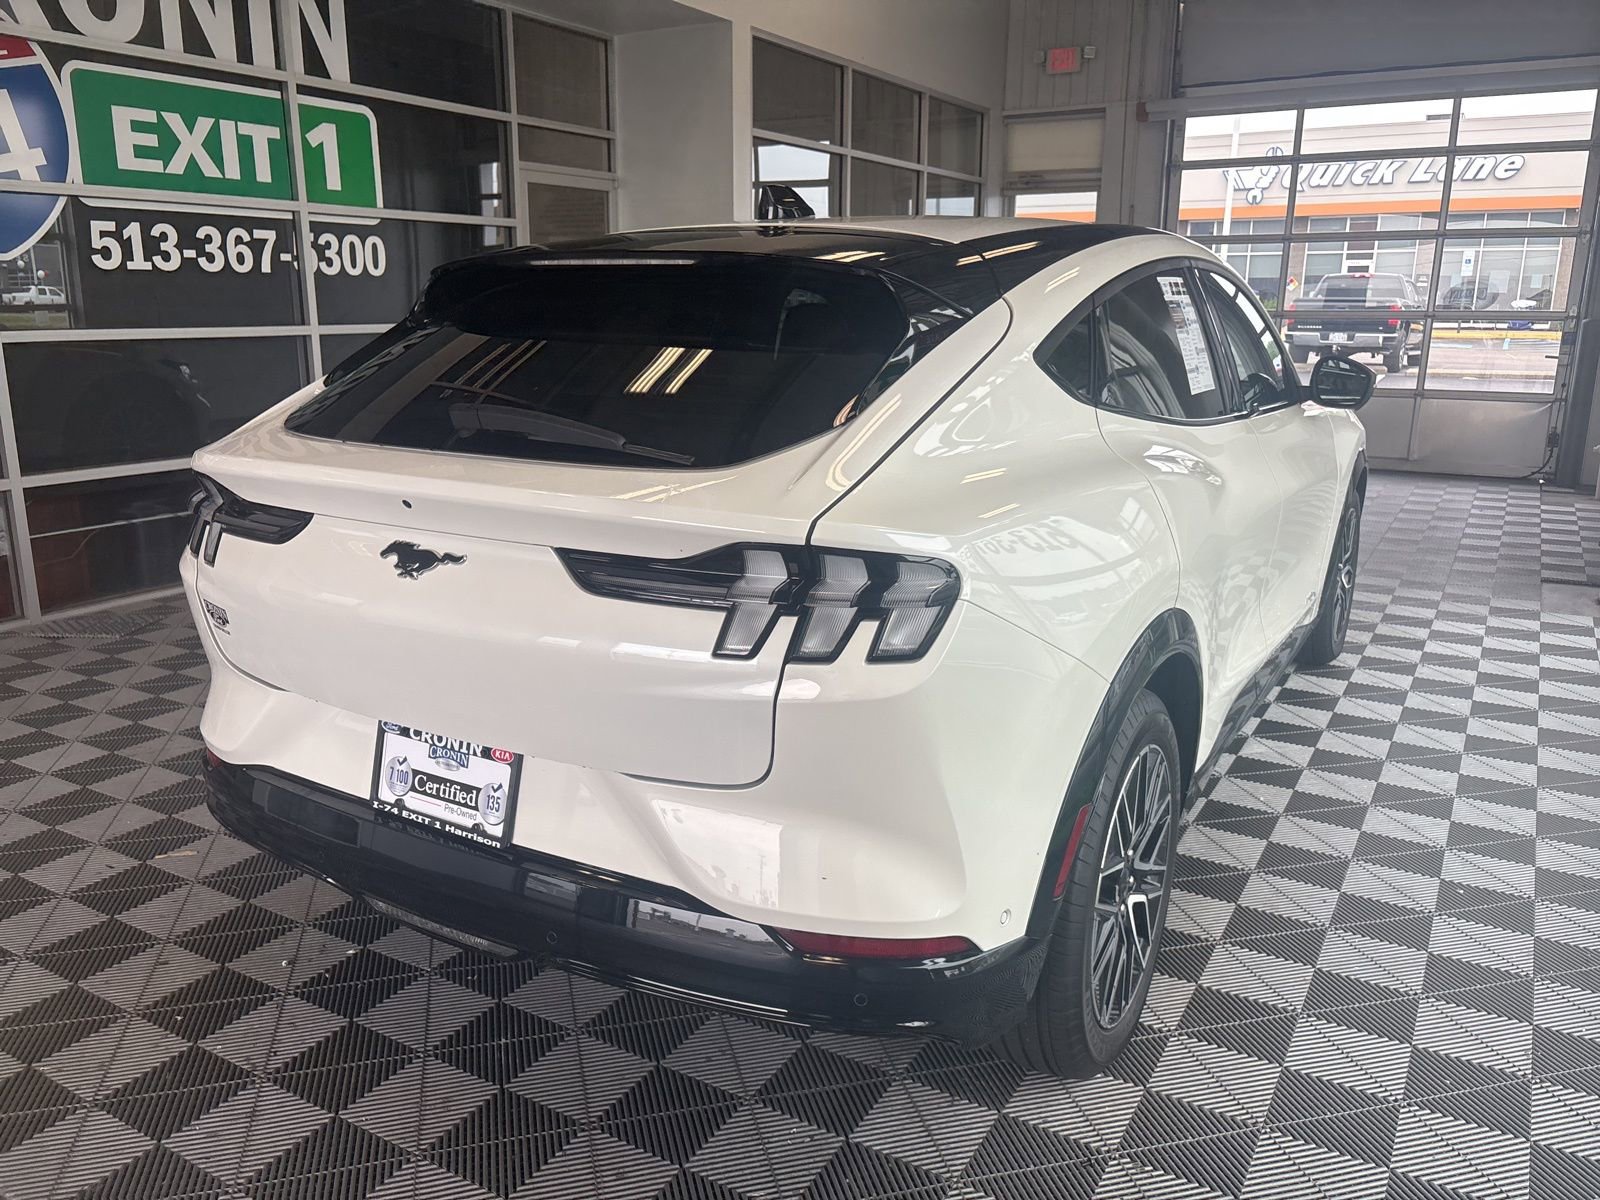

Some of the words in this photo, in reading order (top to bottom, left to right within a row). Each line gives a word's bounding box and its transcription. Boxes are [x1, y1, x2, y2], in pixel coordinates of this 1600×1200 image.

[110, 105, 281, 184] EXIT
[304, 122, 342, 191] 1
[429, 746, 469, 768] CRONIN
[495, 750, 511, 761] KIA
[414, 775, 477, 807] Certified
[443, 803, 478, 821] Pre-Owned
[486, 794, 501, 813] 135
[372, 800, 399, 815] I-74
[401, 810, 431, 825] EXIT
[434, 821, 442, 830] 1
[445, 824, 501, 849] Harrison
